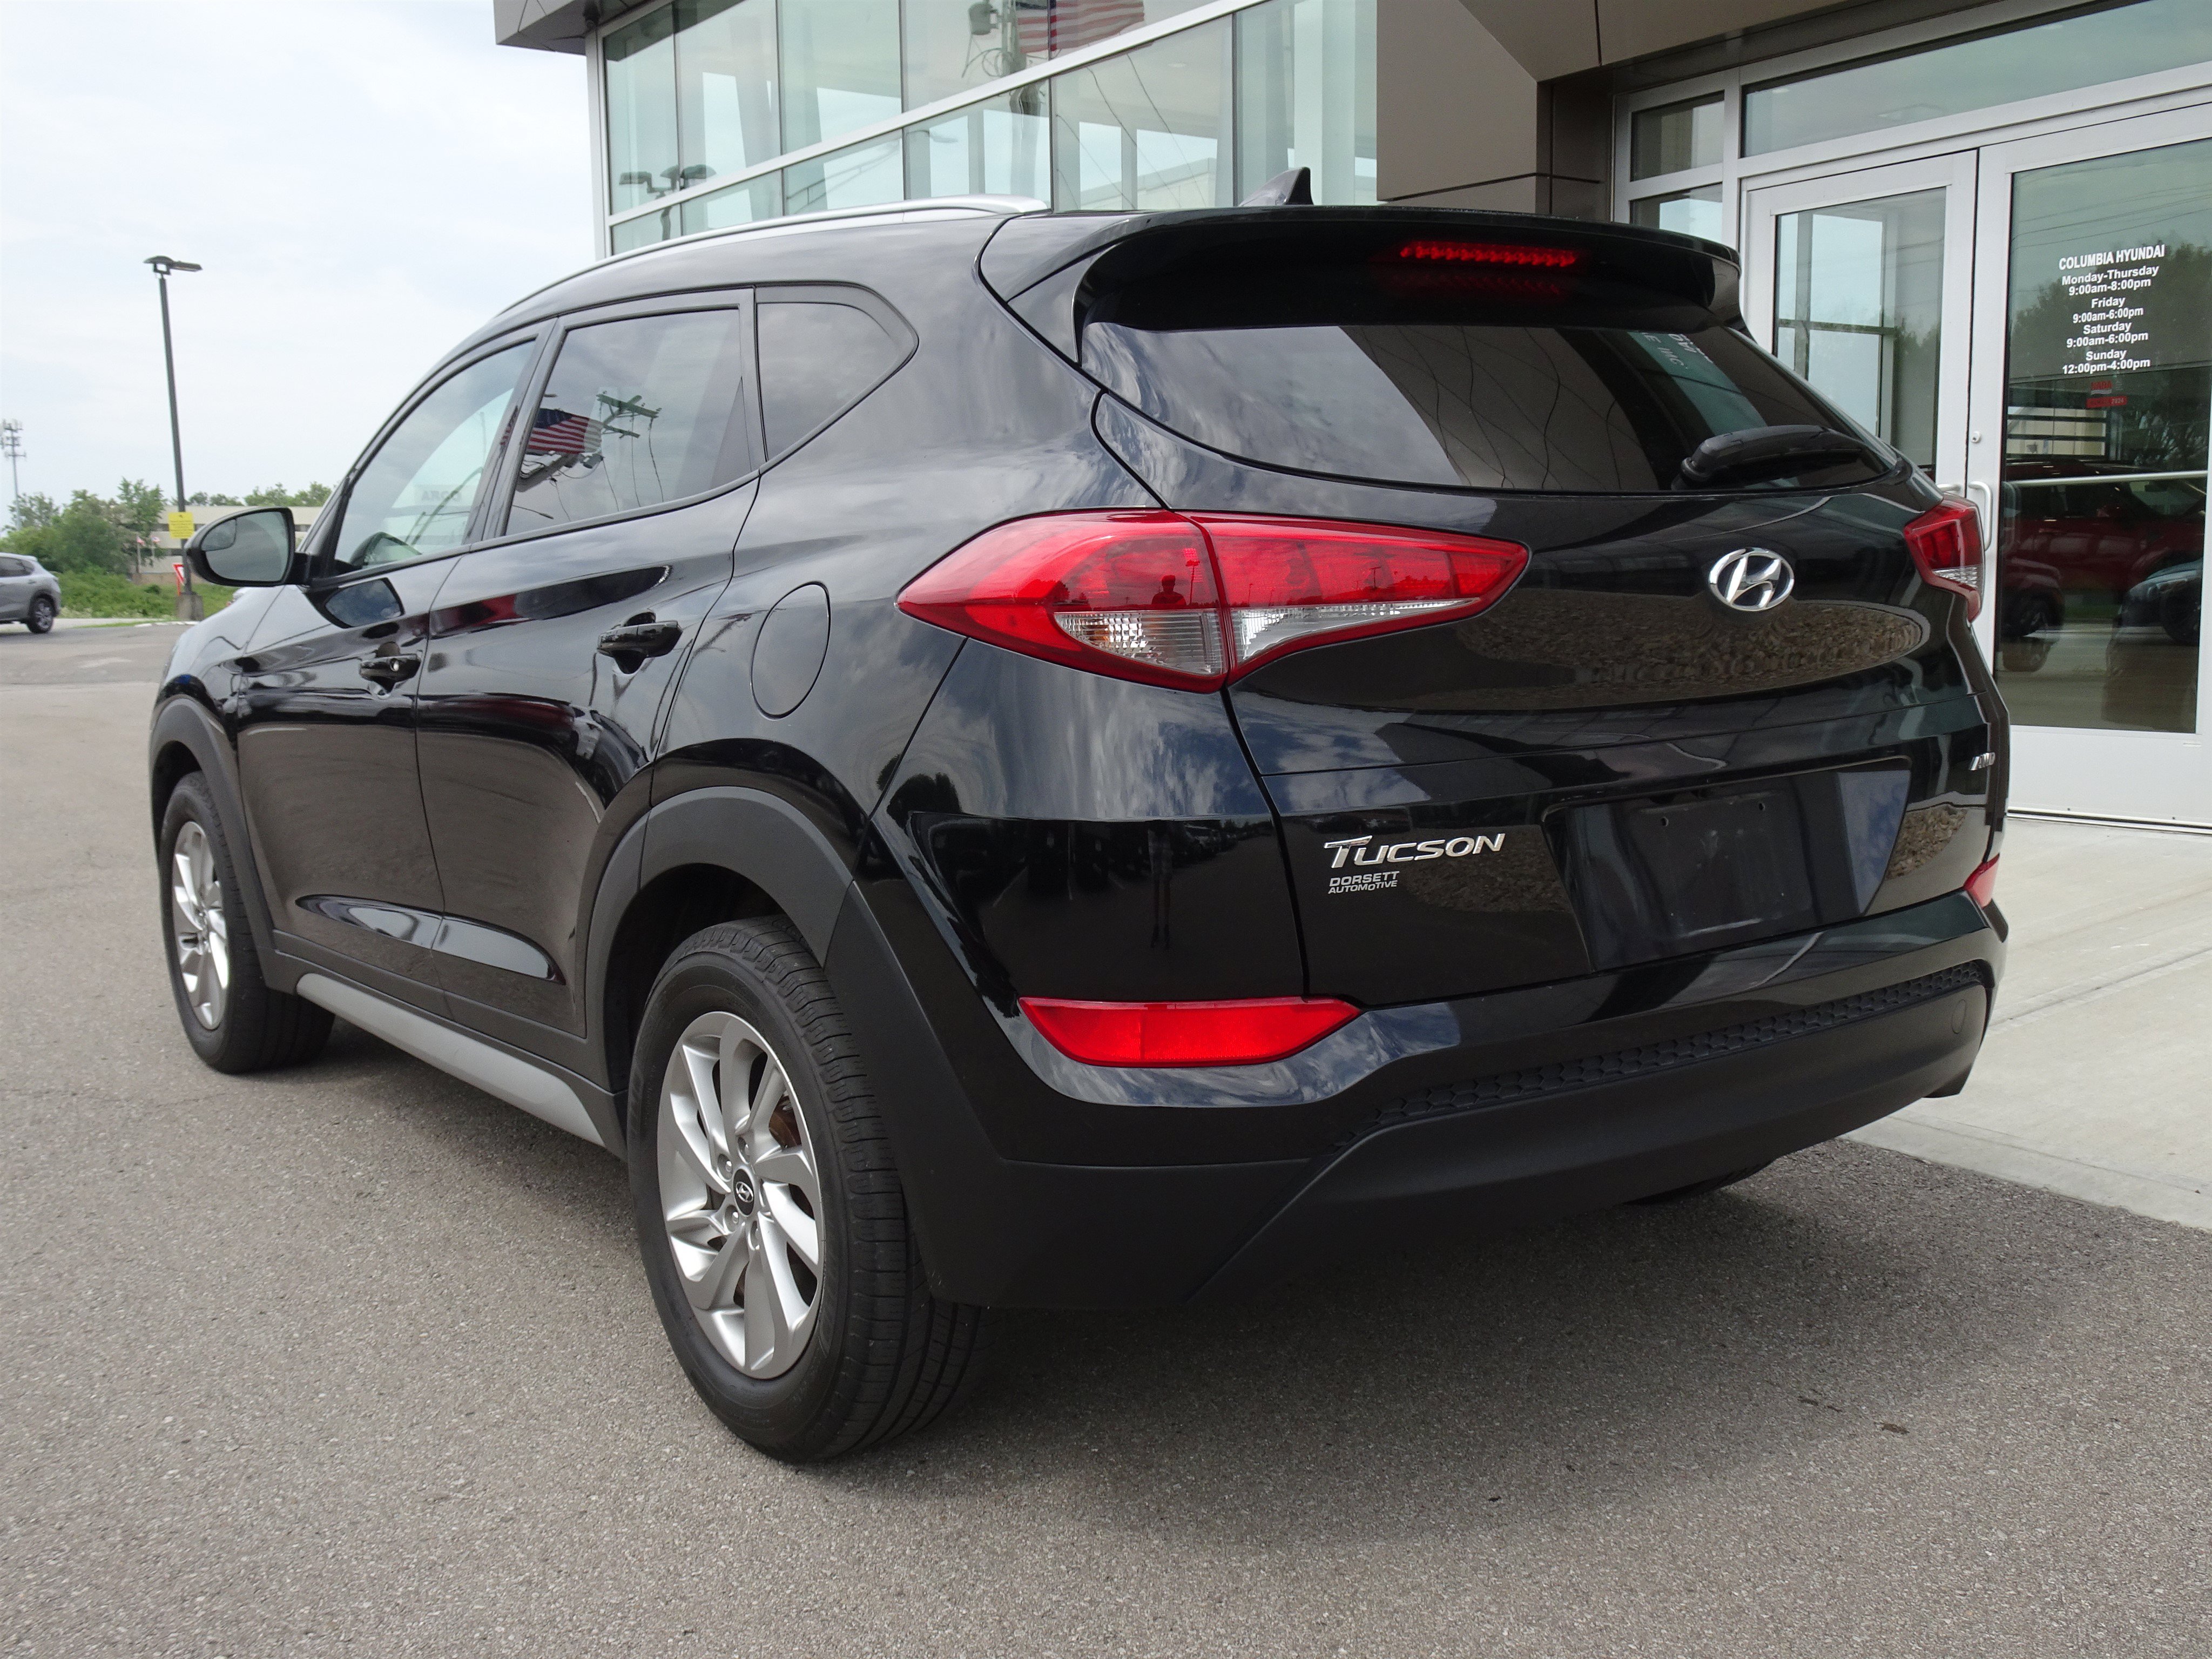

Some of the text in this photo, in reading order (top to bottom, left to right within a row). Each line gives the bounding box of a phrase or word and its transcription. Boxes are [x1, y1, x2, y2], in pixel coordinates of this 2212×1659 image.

[2059, 245, 2165, 270] COLUMBIA HYUNDAI
[2062, 266, 2159, 286] Monday-Thursday
[2068, 278, 2152, 296] 9:00am-8:00pm
[2091, 297, 2126, 308] Friday
[2072, 307, 2144, 323] 9:00am-6:00pm
[2083, 322, 2132, 335] Saturday
[2066, 332, 2149, 348] 9:00am-6:00pm
[2086, 349, 2127, 361] Sunday
[2062, 359, 2151, 374] 12:00pm-4:00pm
[1324, 833, 1505, 868] TUCSON
[1328, 880, 1398, 894] AUTOMOTIVE
[1329, 871, 1400, 887] DORSETT
